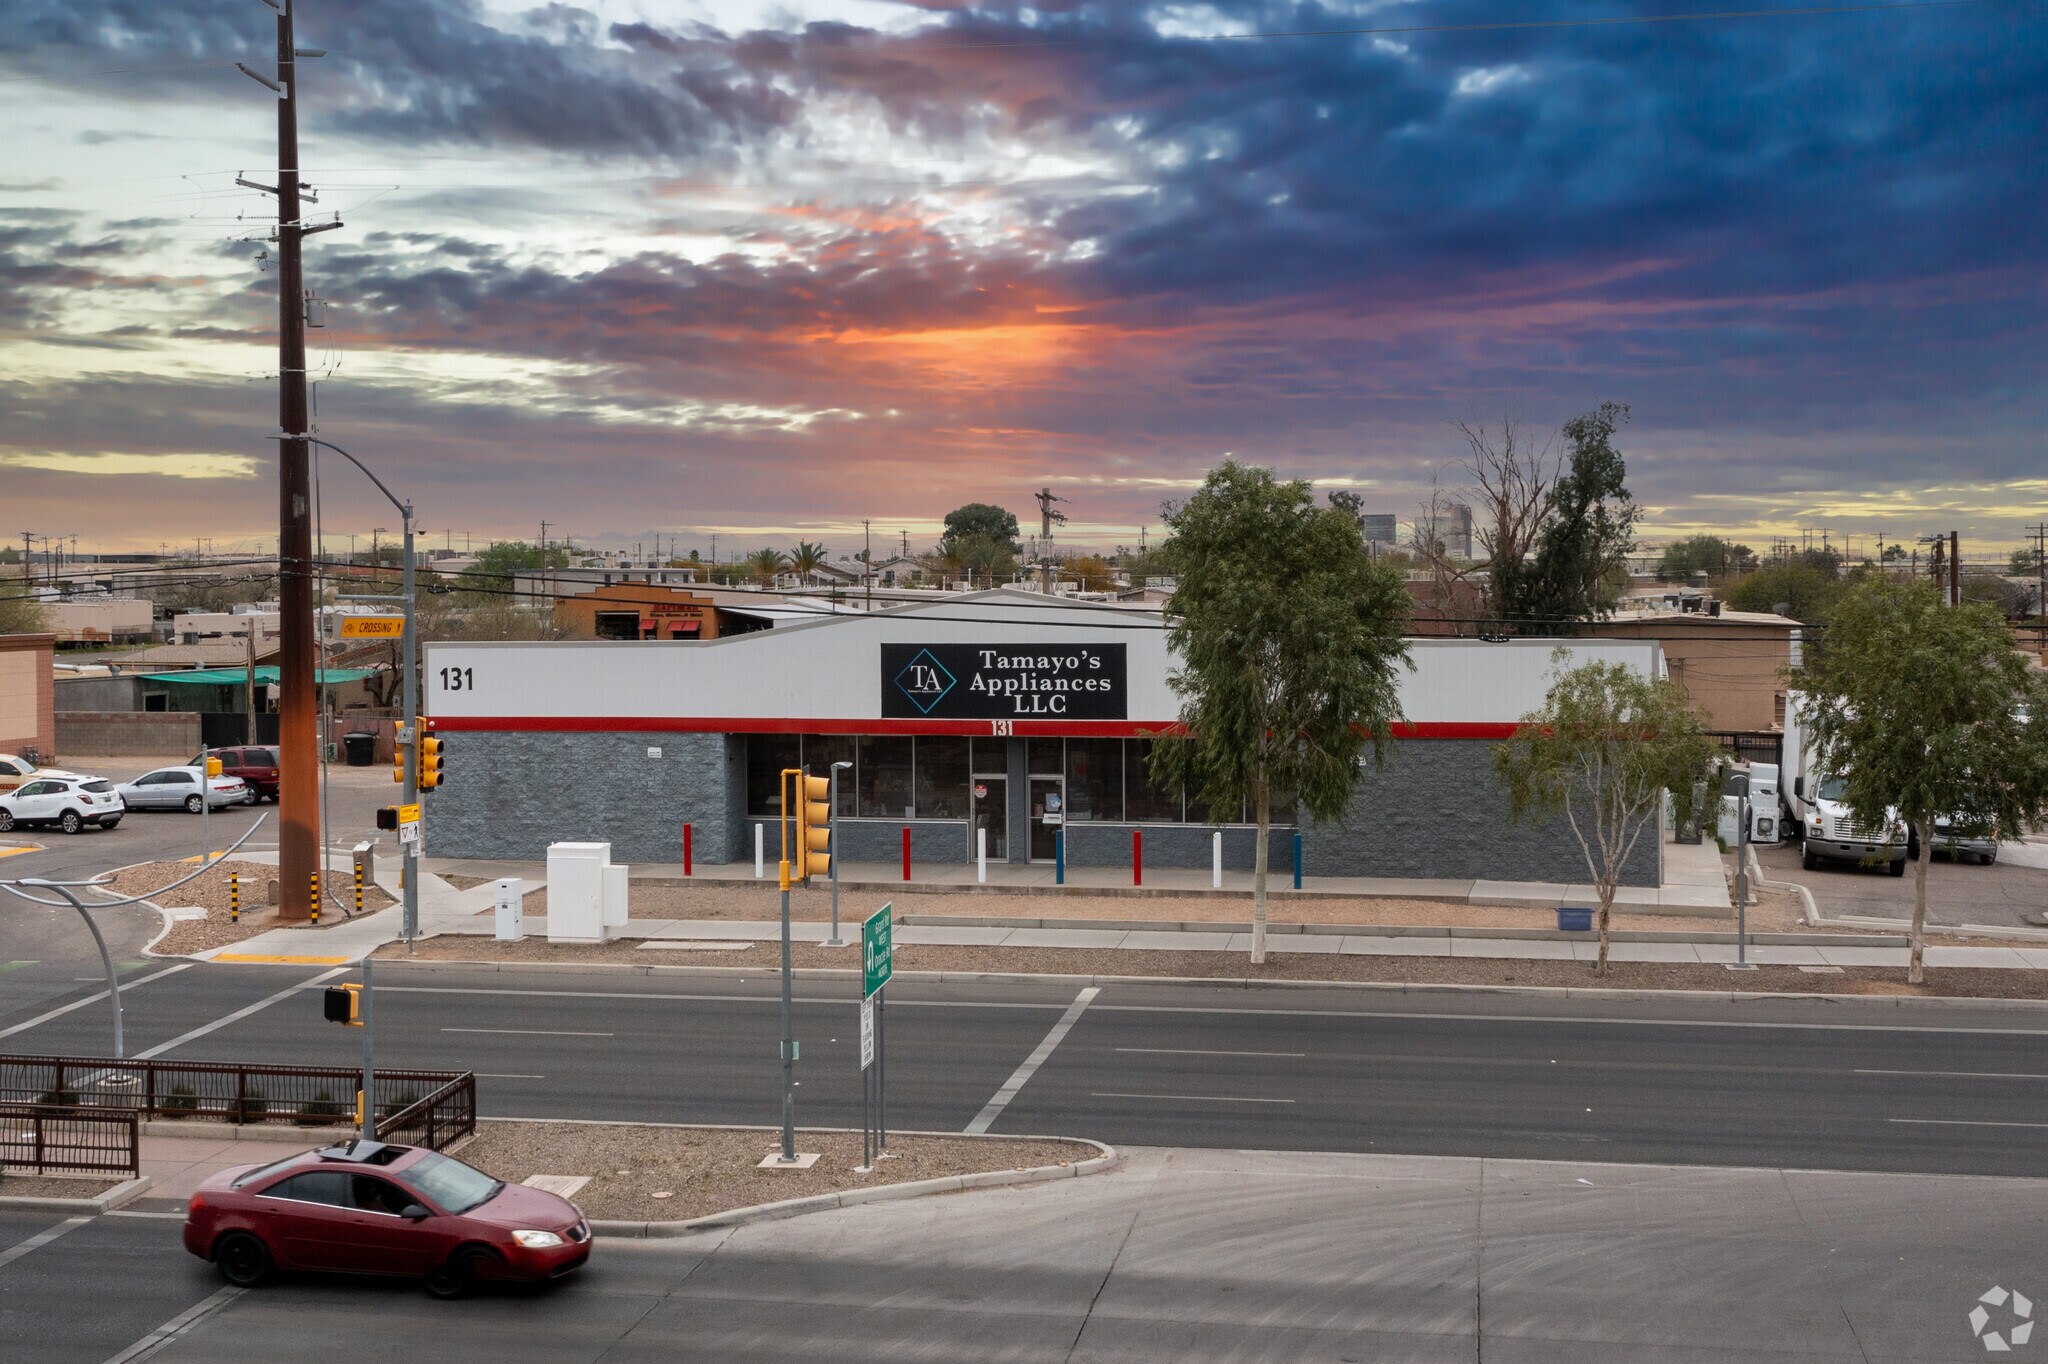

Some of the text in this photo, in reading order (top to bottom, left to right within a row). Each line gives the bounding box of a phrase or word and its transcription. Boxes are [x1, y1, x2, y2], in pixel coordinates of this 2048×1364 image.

[359, 622, 392, 633] CROSSING
[979, 650, 1101, 675] Tamayo's
[440, 667, 472, 690] 131
[910, 665, 942, 691] TA
[969, 672, 1112, 696] Appliances
[1013, 694, 1067, 713] LLC
[991, 720, 1013, 736] 131
